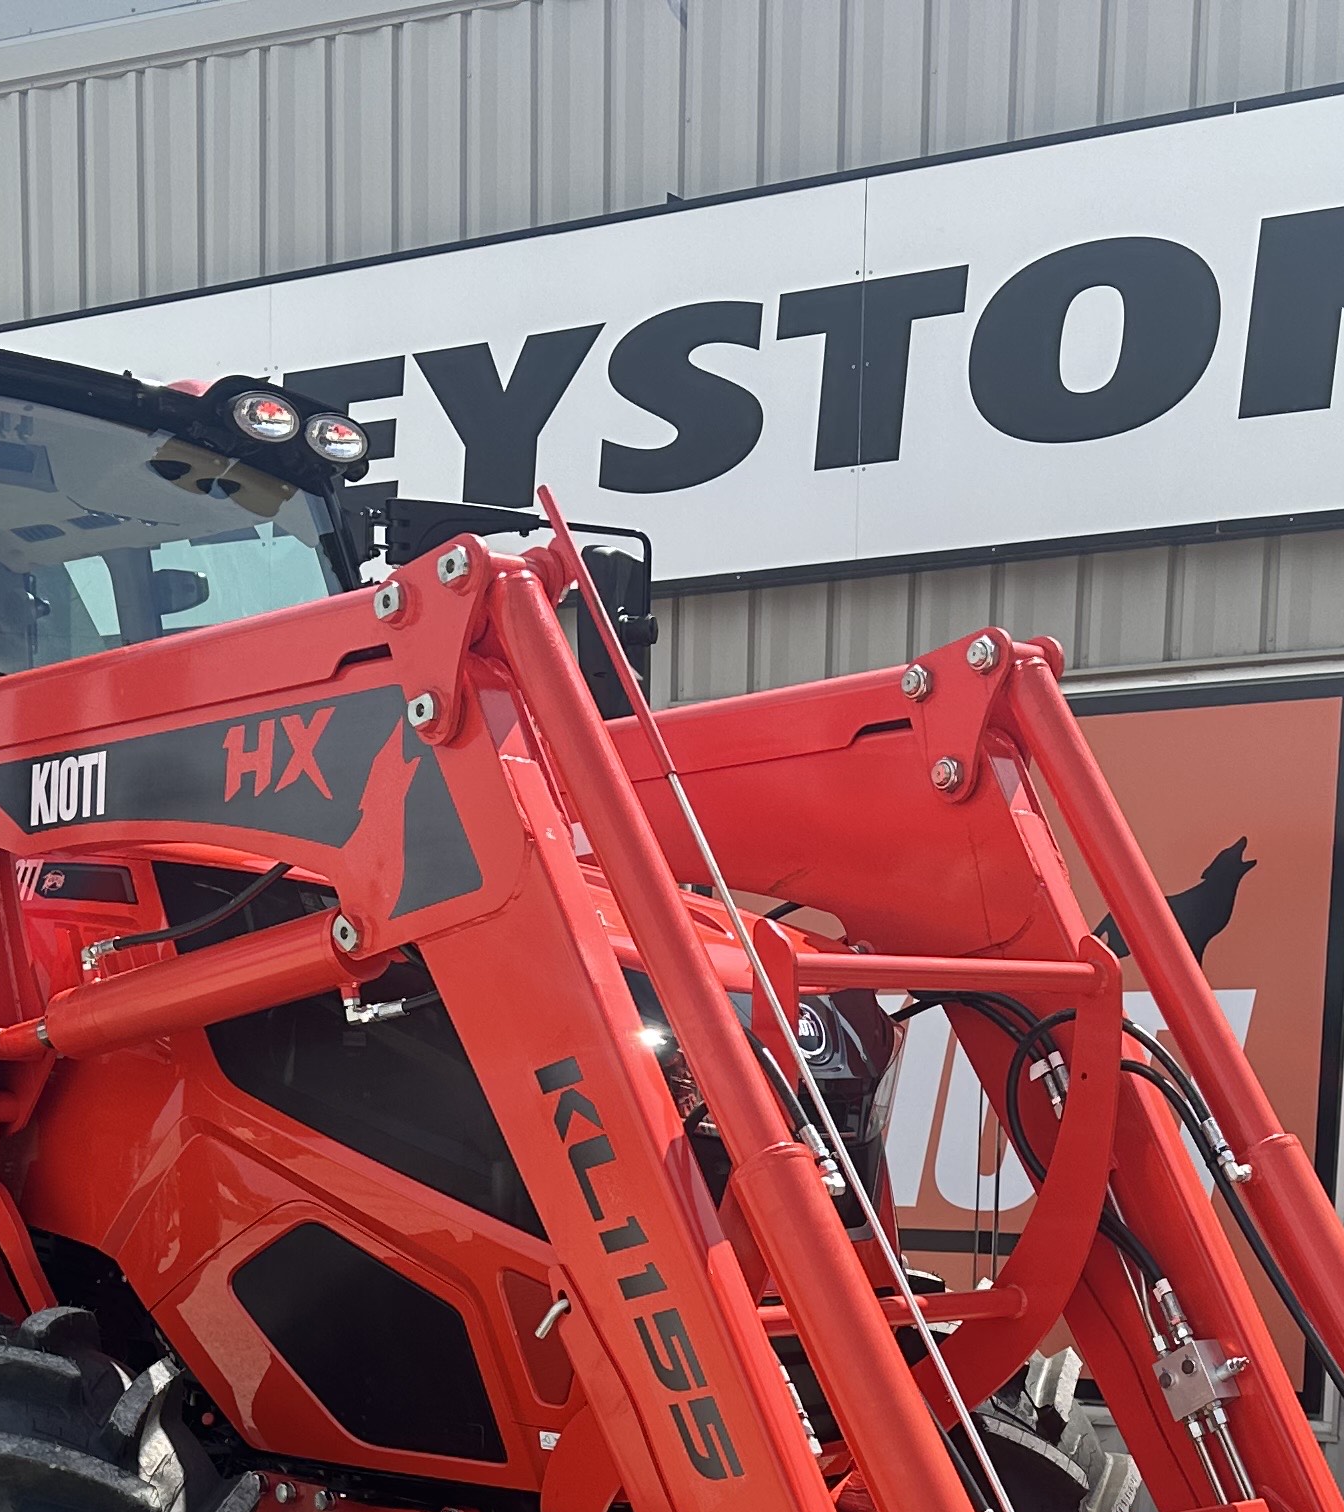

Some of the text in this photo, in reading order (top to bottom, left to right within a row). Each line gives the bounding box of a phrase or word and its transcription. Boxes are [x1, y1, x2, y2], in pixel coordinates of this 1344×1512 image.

[29, 750, 107, 827] KIOTI
[222, 706, 337, 803] HX
[534, 1055, 746, 1481] KL1155
